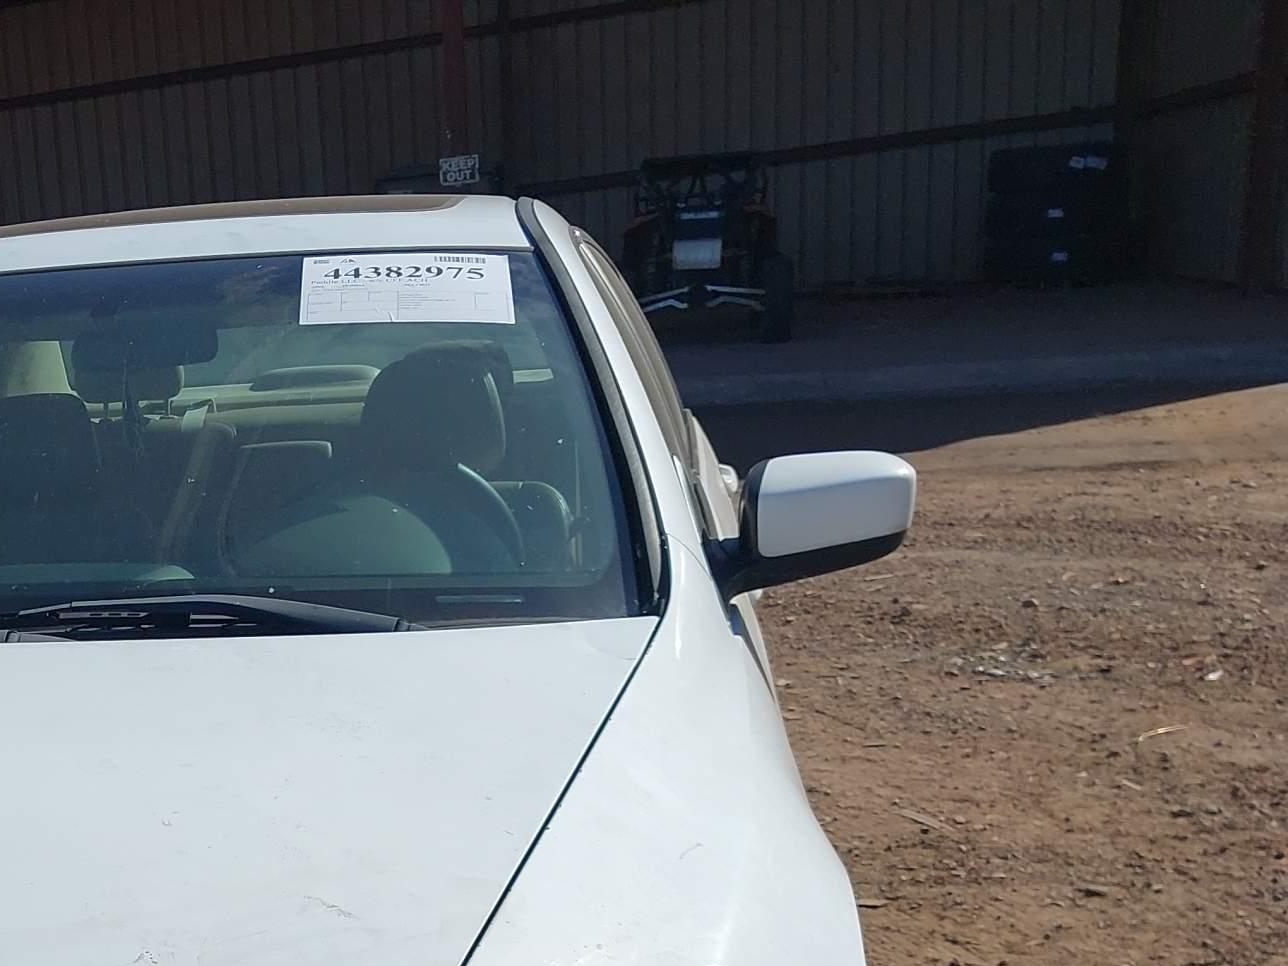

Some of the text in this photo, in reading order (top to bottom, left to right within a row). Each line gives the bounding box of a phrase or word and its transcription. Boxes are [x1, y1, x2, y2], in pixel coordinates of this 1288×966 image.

[442, 158, 475, 171] KEEP
[447, 170, 472, 181] OUT
[324, 265, 484, 280] 44382975
